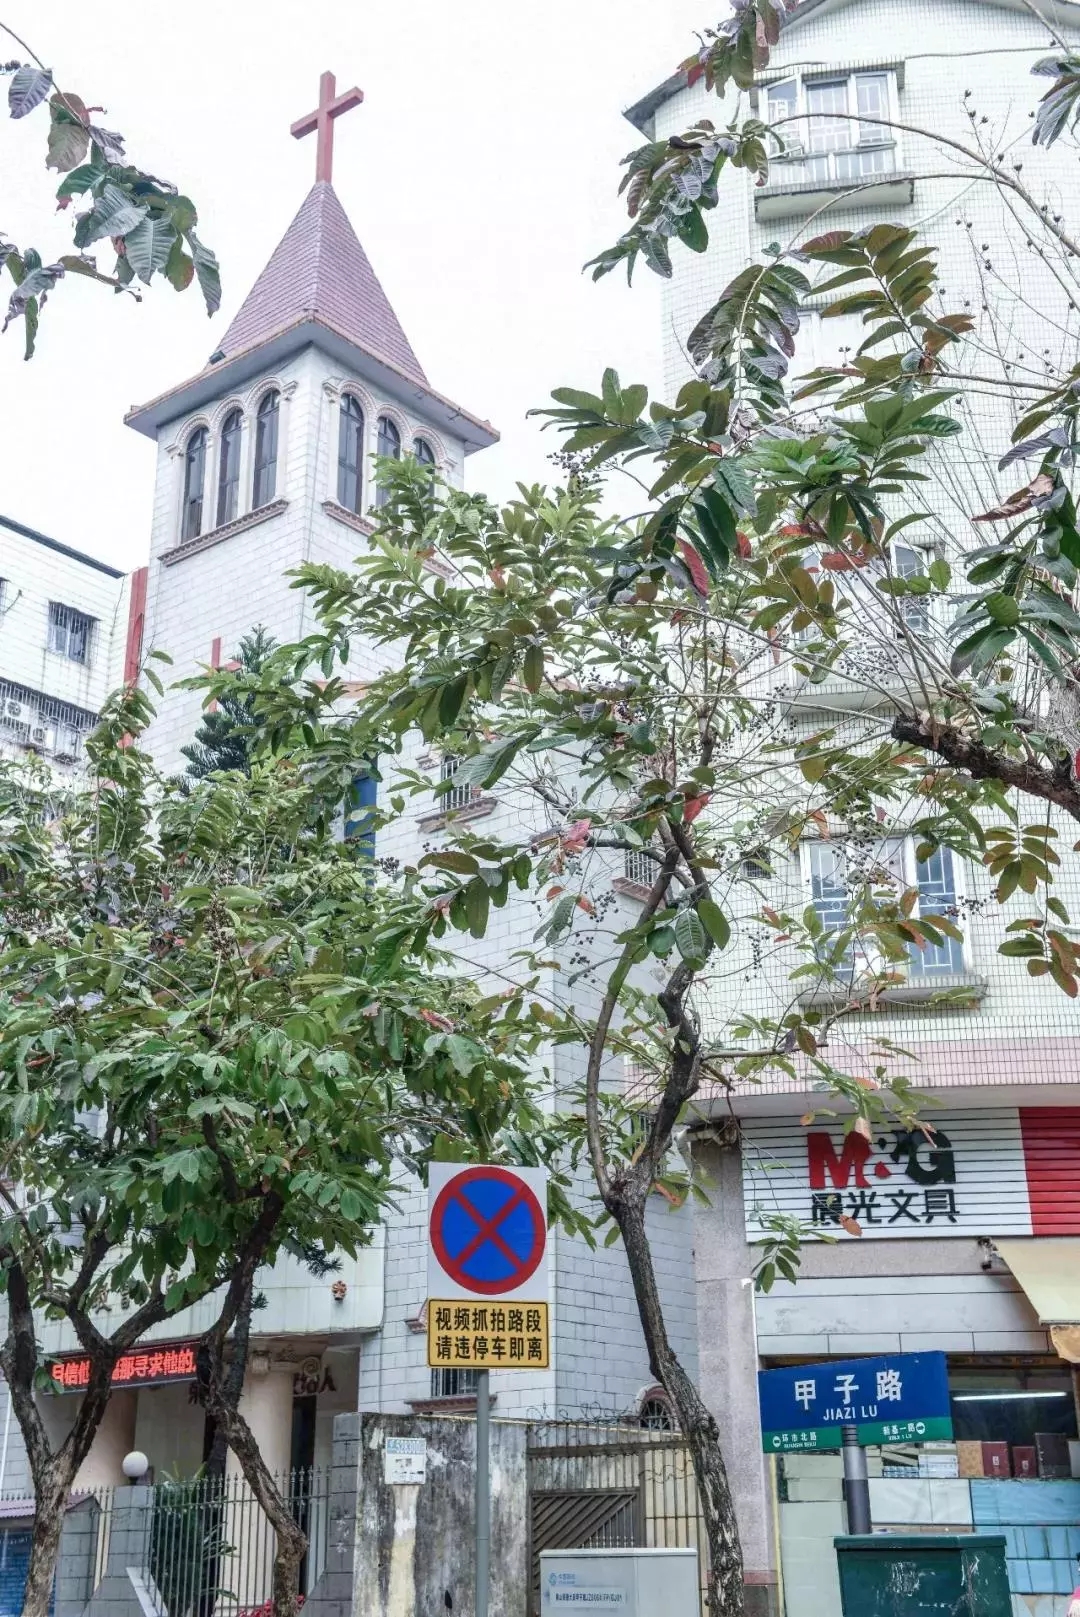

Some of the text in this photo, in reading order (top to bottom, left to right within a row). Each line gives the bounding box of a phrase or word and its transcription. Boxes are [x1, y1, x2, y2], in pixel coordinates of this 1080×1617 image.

[811, 1189, 960, 1226] 晨光文具
[435, 1307, 541, 1332] 视频抓拍路段
[435, 1335, 542, 1360] 请违停车即离
[794, 1369, 902, 1411] 甲子路
[823, 1405, 878, 1420] JIAZI LU
[782, 1432, 817, 1442] 环市北路
